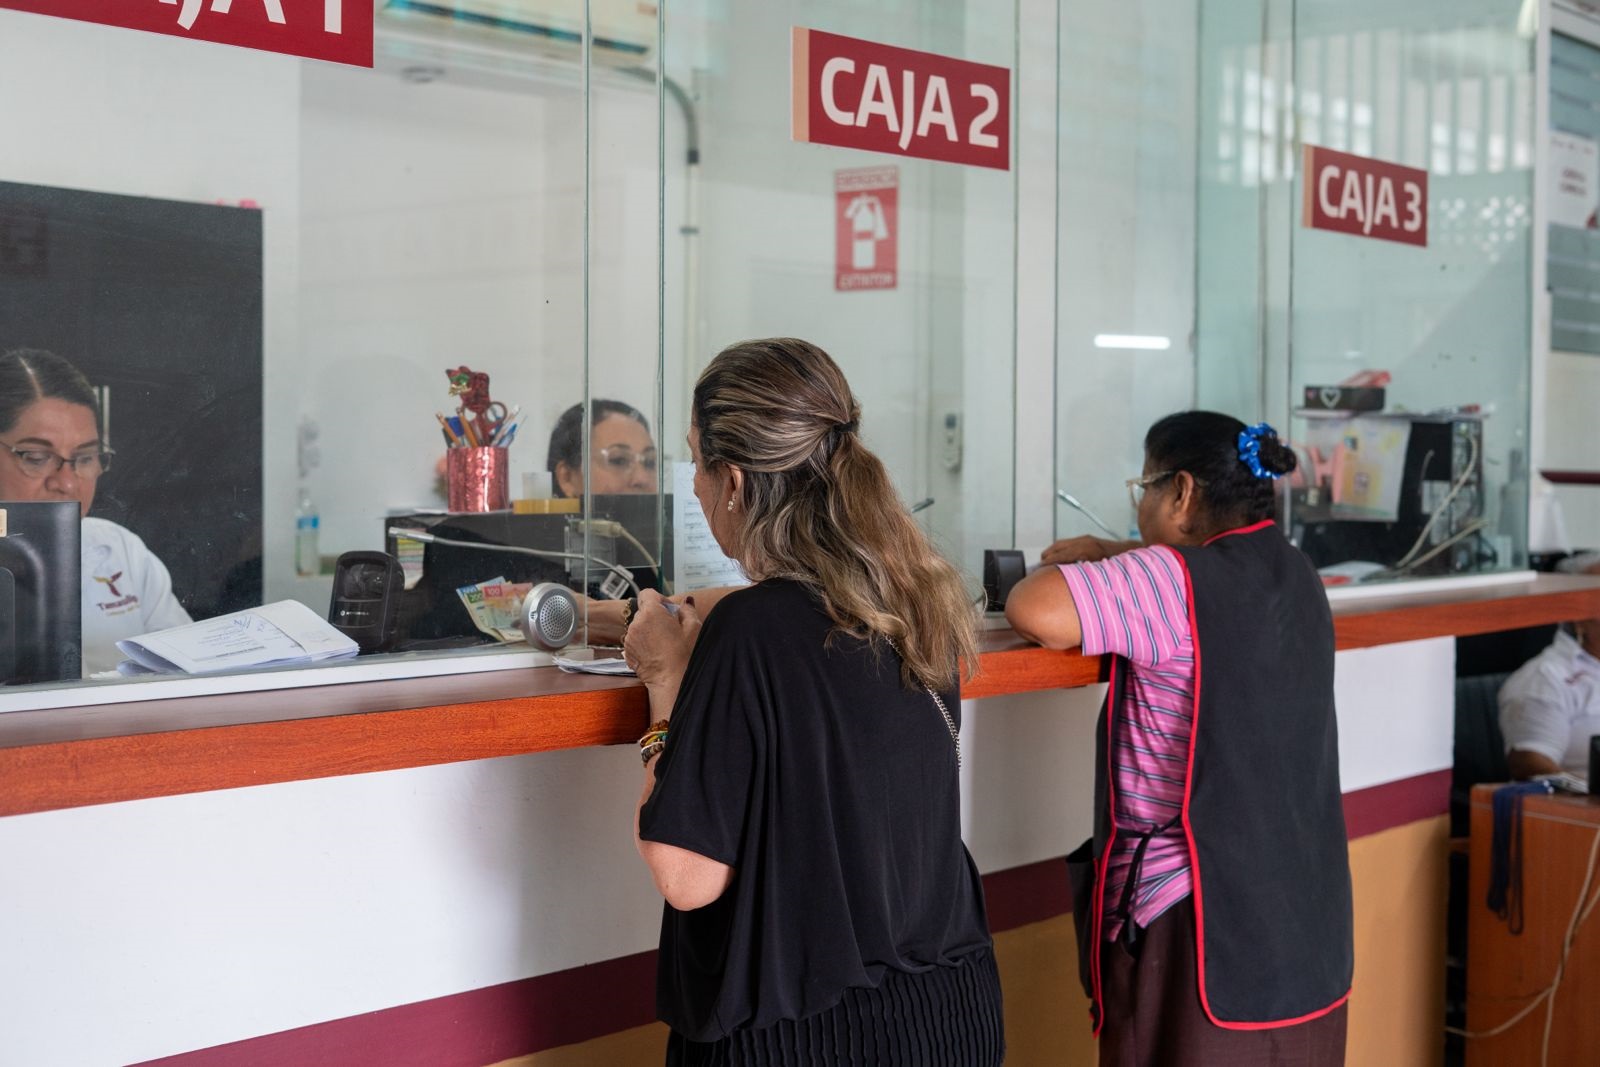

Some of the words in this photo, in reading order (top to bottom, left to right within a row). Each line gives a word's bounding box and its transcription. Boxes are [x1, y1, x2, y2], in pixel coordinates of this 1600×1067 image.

[820, 57, 959, 151] CAJA
[968, 83, 999, 148] 2
[1319, 165, 1399, 235] CAJA
[1403, 181, 1422, 232] 3
